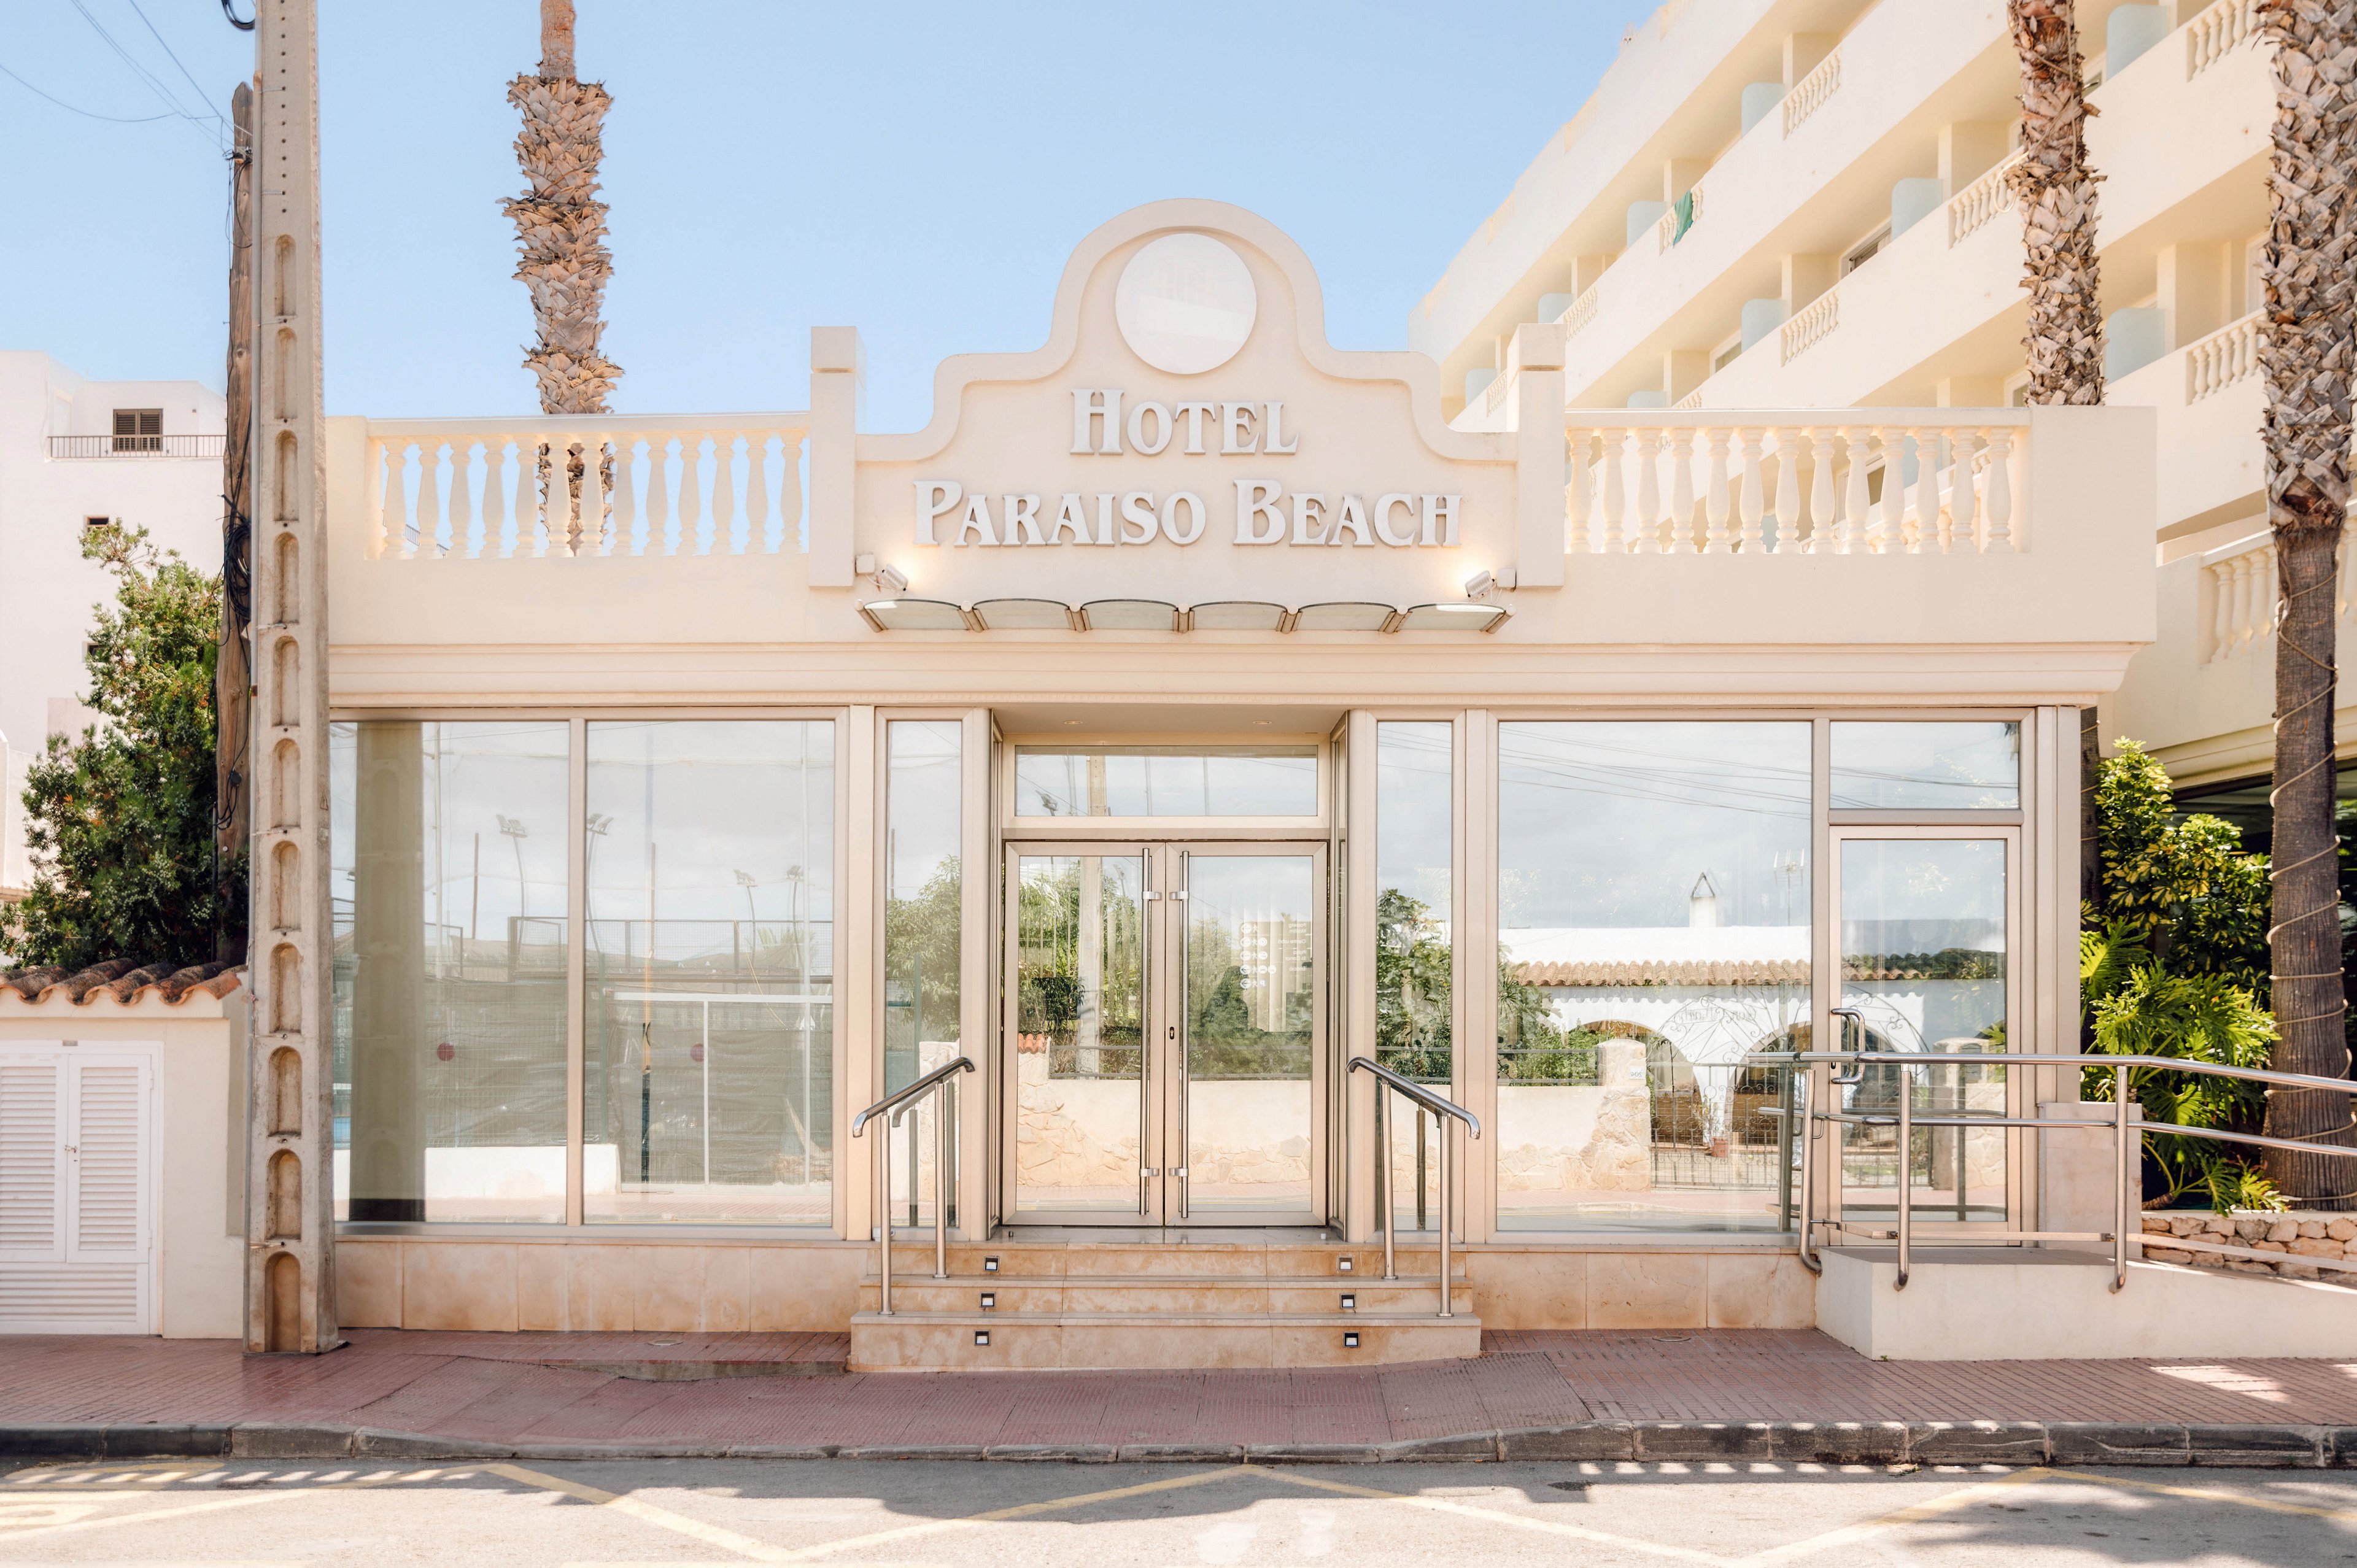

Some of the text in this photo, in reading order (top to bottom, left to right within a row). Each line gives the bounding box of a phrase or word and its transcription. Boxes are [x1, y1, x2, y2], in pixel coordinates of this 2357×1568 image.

[1069, 388, 1299, 457] HOTEL
[913, 478, 1463, 547] PARAISO BEACH
